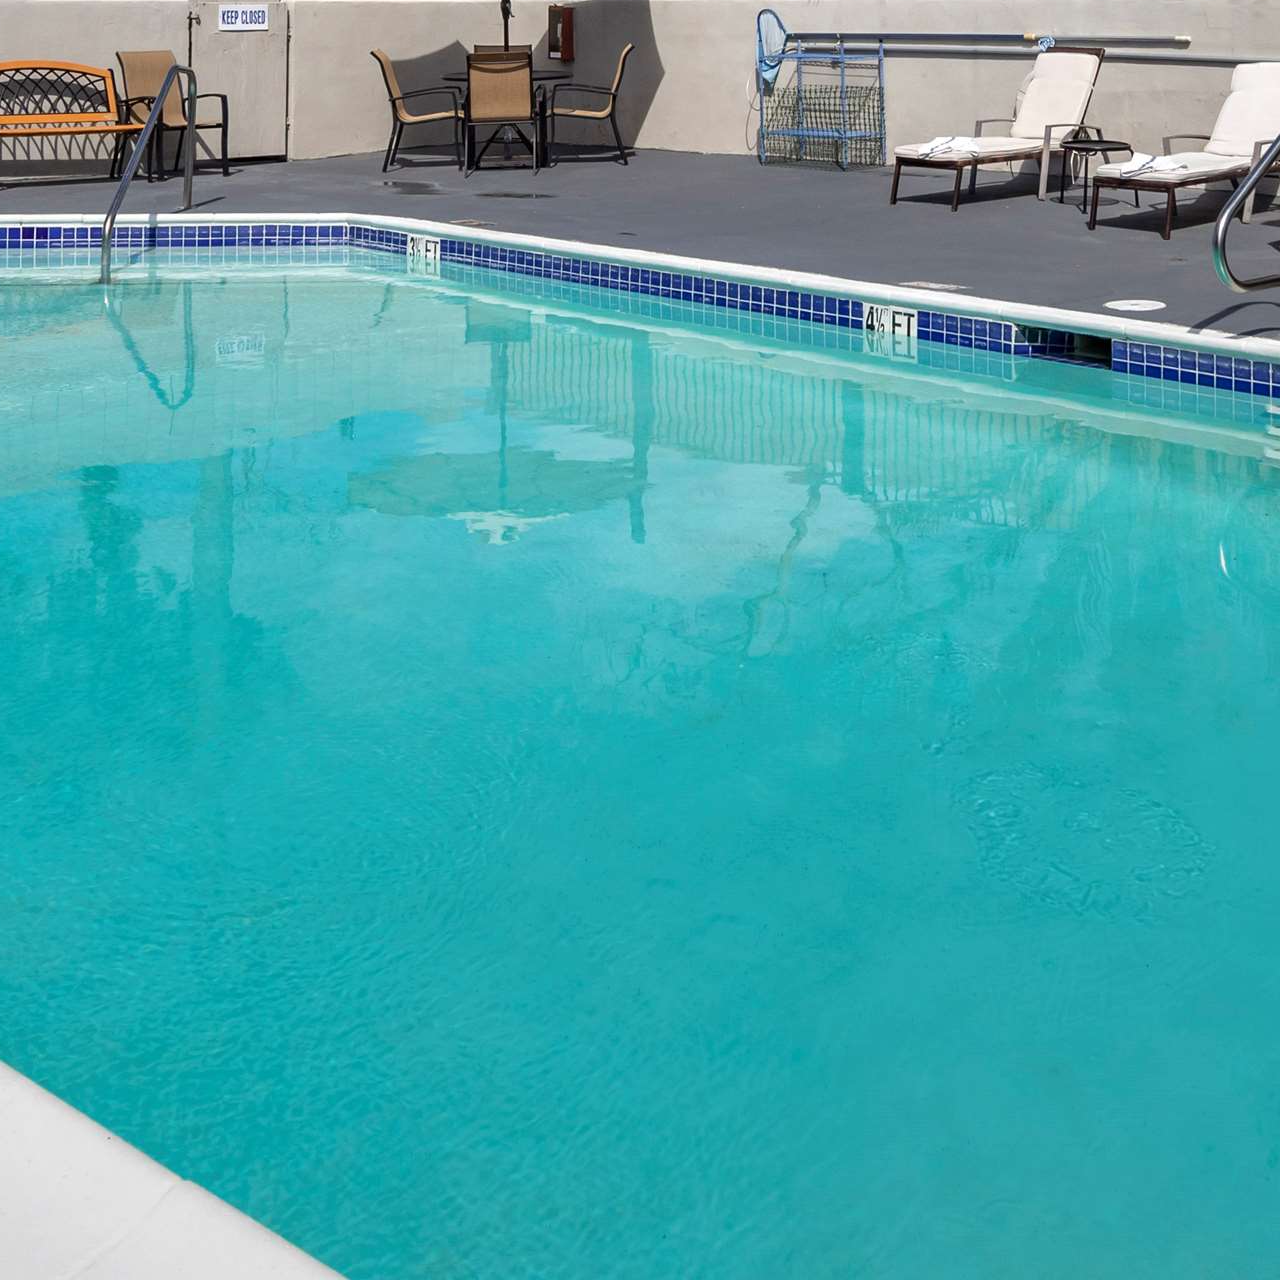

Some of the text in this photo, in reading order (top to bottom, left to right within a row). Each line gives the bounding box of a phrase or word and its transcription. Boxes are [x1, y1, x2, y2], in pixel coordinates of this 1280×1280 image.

[221, 10, 266, 25] KEEP CLOSED
[425, 239, 439, 260] FT
[892, 311, 915, 337] FT
